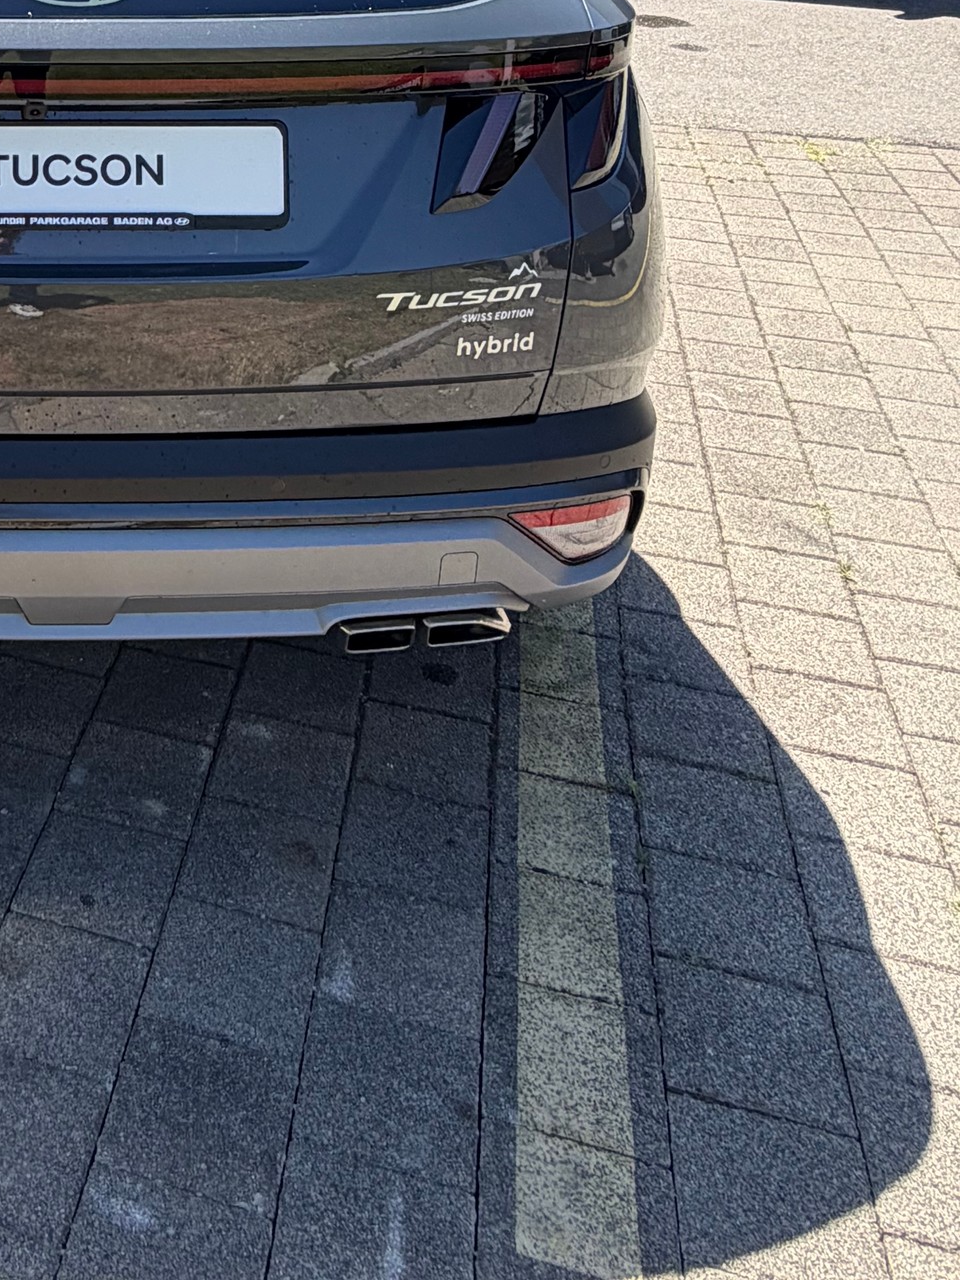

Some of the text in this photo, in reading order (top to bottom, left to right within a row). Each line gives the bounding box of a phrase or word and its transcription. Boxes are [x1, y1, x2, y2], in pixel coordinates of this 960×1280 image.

[29, 216, 109, 226] PARKGARAGE
[113, 216, 153, 225] BADEN
[155, 216, 173, 225] AG
[461, 308, 534, 323] SWISS EDITION
[456, 331, 535, 360] hybrid
